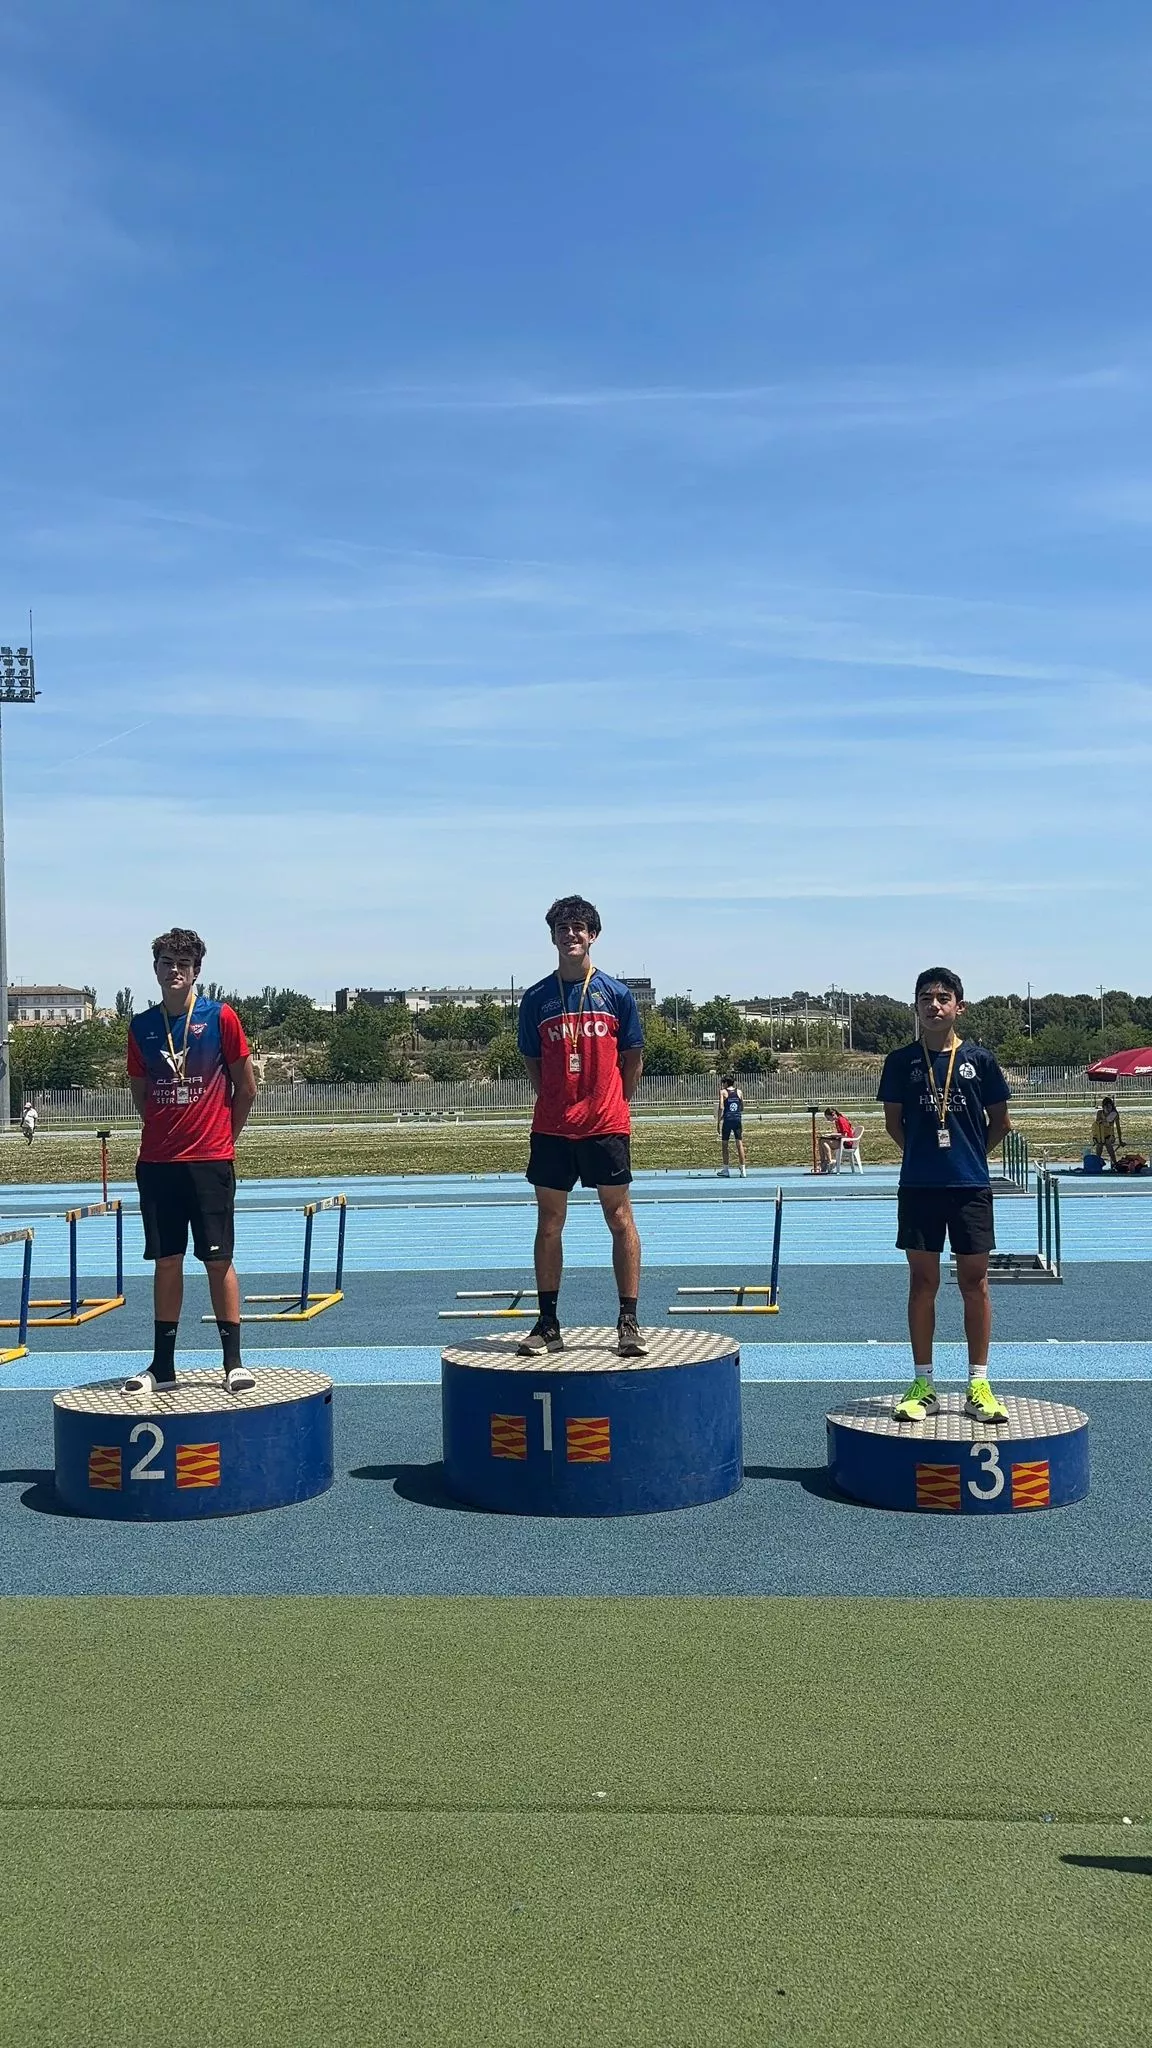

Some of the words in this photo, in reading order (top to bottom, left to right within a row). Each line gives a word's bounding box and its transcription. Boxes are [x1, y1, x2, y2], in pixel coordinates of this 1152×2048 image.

[533, 1392, 552, 1451] 1
[129, 1422, 165, 1480] 2
[967, 1442, 1005, 1500] 3
